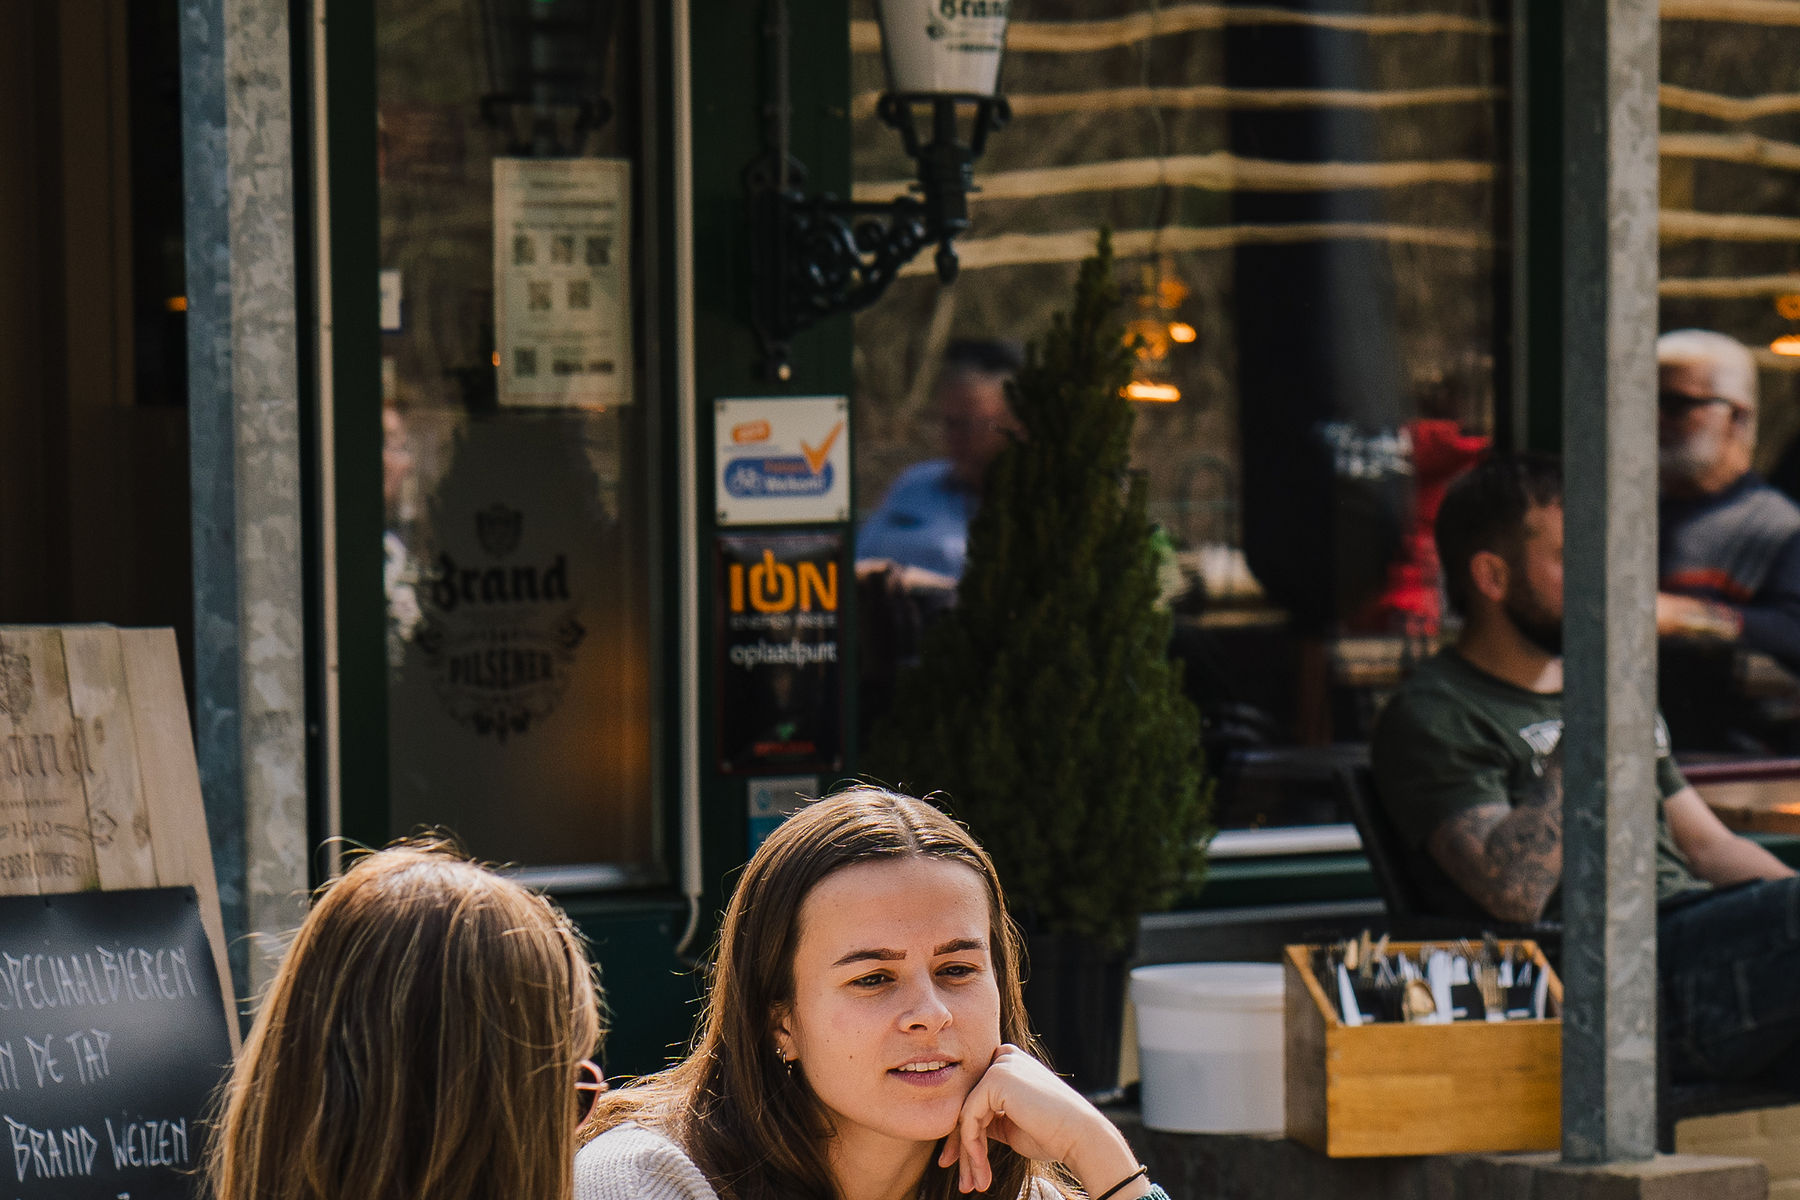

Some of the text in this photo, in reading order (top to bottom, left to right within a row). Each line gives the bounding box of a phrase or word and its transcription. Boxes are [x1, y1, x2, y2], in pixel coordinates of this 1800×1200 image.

[428, 551, 571, 613] Brand
[729, 549, 838, 613] ION
[66, 1027, 112, 1086] TAP
[4, 1114, 189, 1182] BRAND WEIZEN
